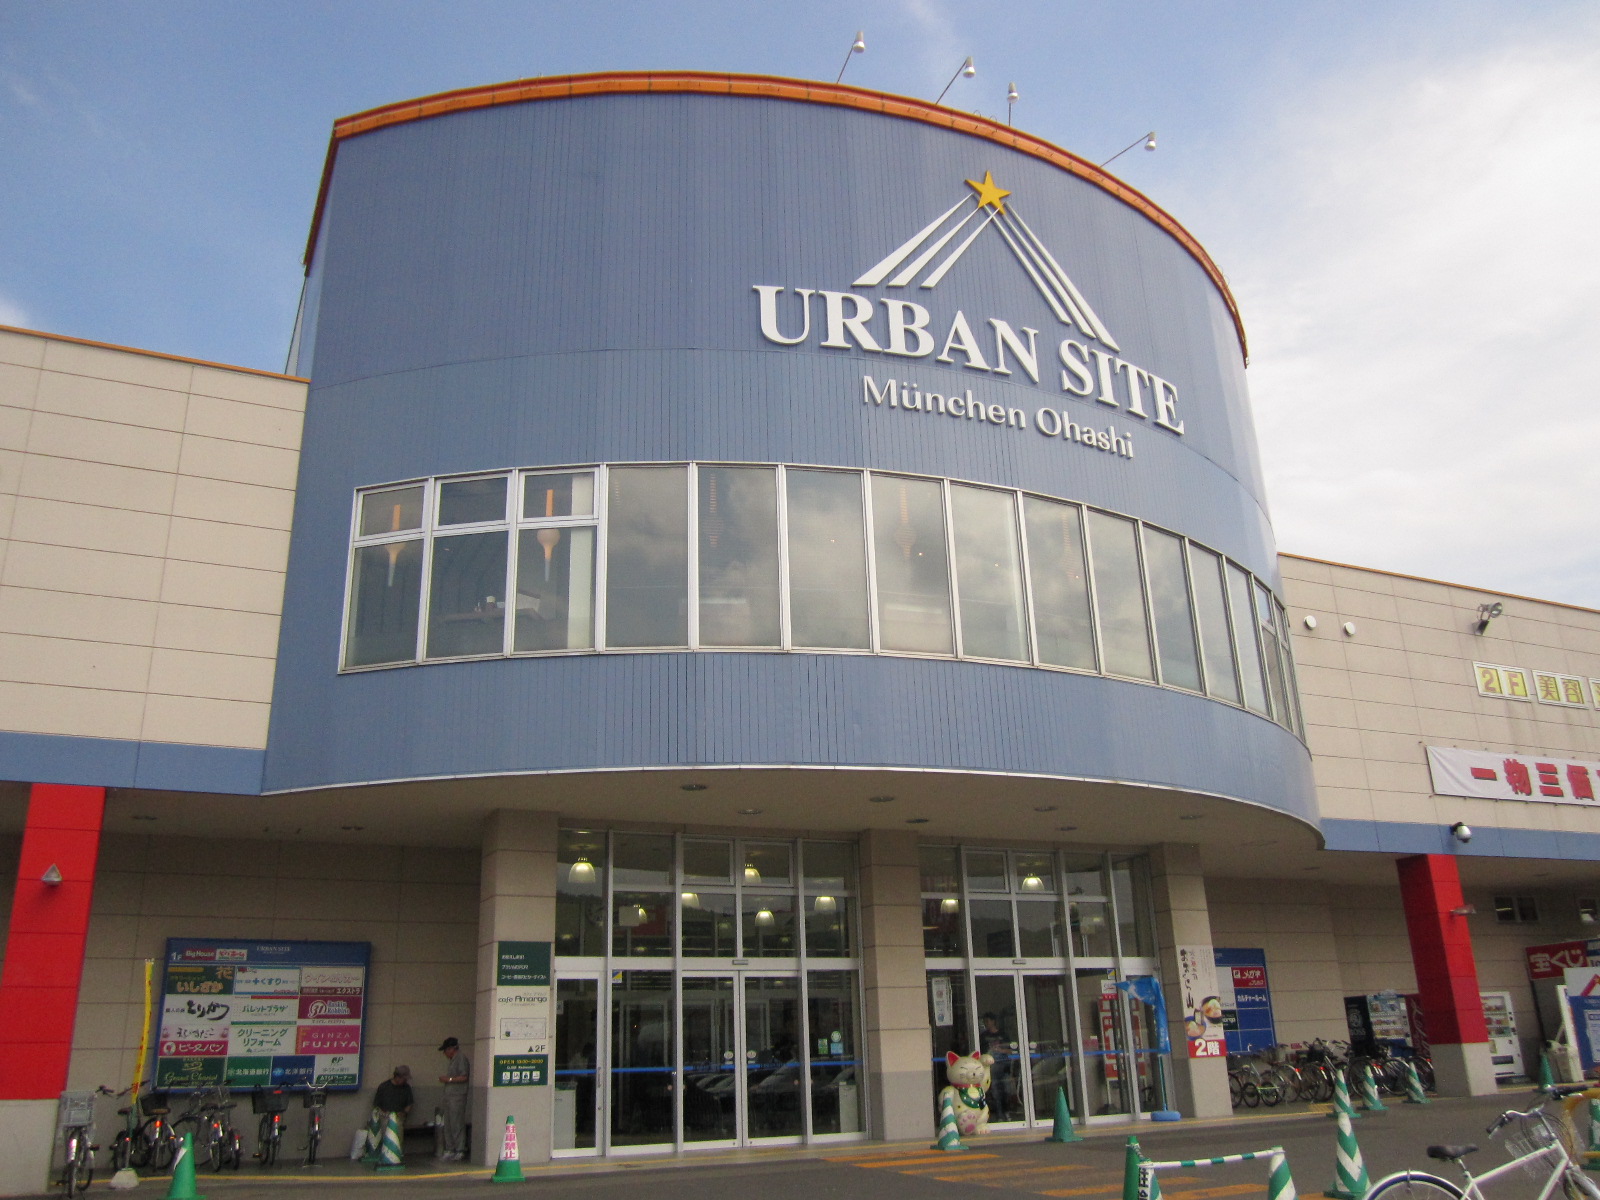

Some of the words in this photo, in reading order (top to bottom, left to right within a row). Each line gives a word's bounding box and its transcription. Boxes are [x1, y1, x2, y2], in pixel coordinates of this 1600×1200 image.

[752, 285, 1039, 383] URBAN
[1059, 339, 1185, 435] SITE
[863, 375, 1026, 429] München
[1035, 407, 1134, 459] Ohashi
[1529, 949, 1584, 973] 宝くじ
[336, 987, 360, 995] エクストラ
[238, 1028, 289, 1037] クリーニング
[179, 1043, 224, 1052] ピーターパン
[243, 1038, 281, 1047] リフォーム
[535, 1044, 546, 1052] 2F
[1194, 1038, 1220, 1057] 2階
[505, 1125, 516, 1160] 駐車禁止
